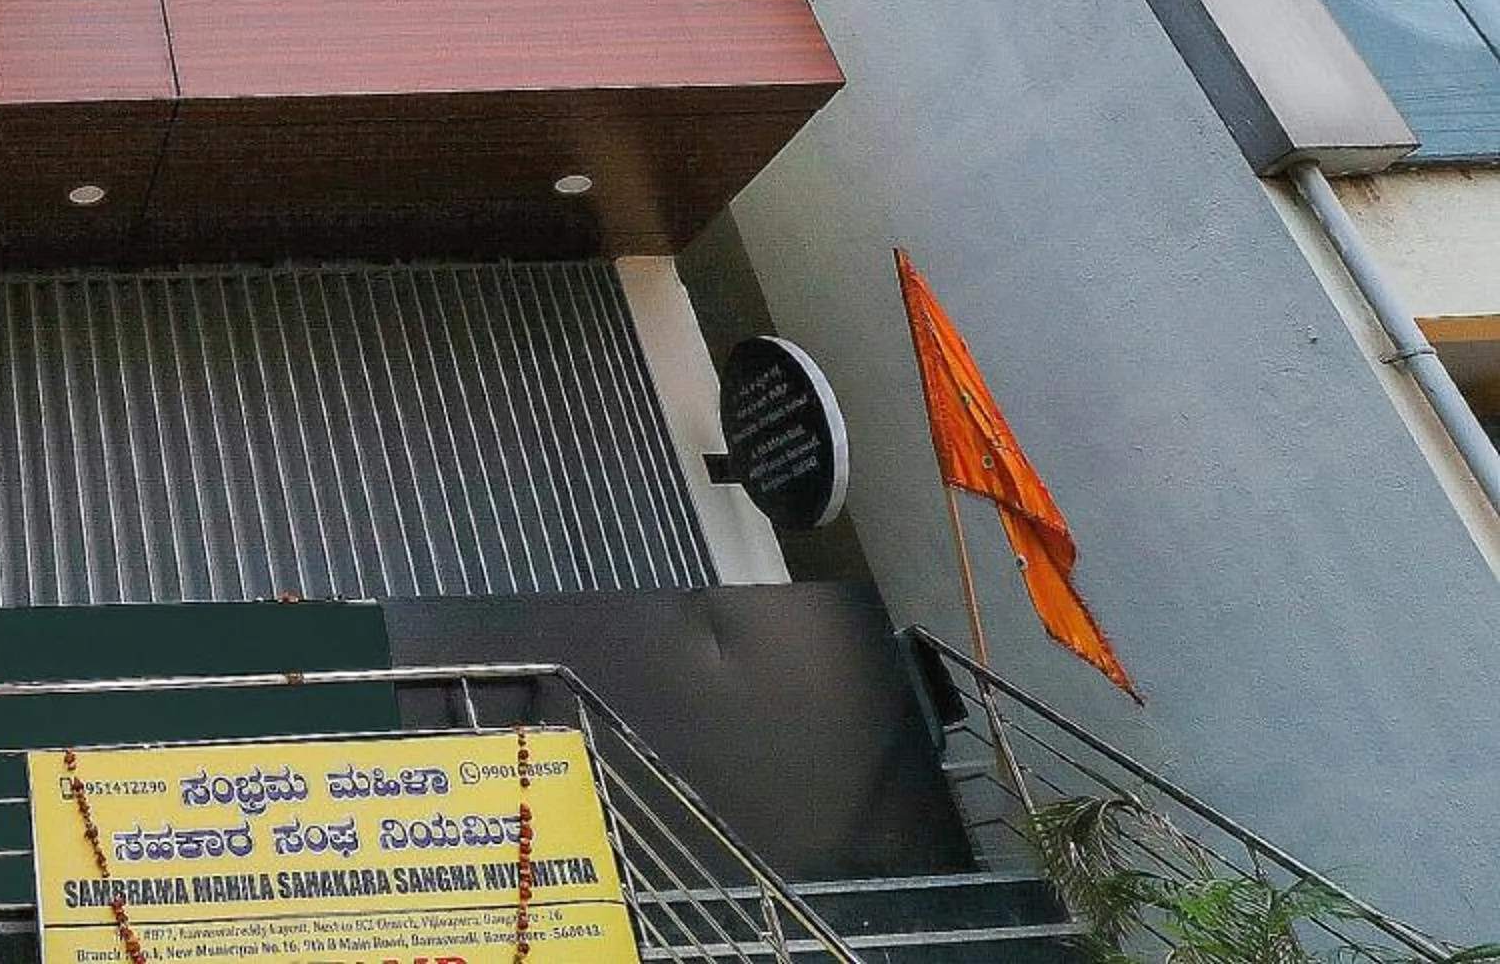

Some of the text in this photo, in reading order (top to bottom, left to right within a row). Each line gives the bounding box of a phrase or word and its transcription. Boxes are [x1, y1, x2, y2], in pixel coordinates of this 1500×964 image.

[179, 764, 449, 815] ಸಂಭ್ರಮ ಮಹಿಳಾ
[113, 823, 253, 861] ಸಹಕಾರ
[272, 819, 359, 858] ಸಂಘ
[192, 873, 274, 902] MAHILA
[277, 865, 392, 898] SAHAKARA
[394, 864, 480, 893] SANGHA
[481, 858, 598, 890] NIYMITHA
